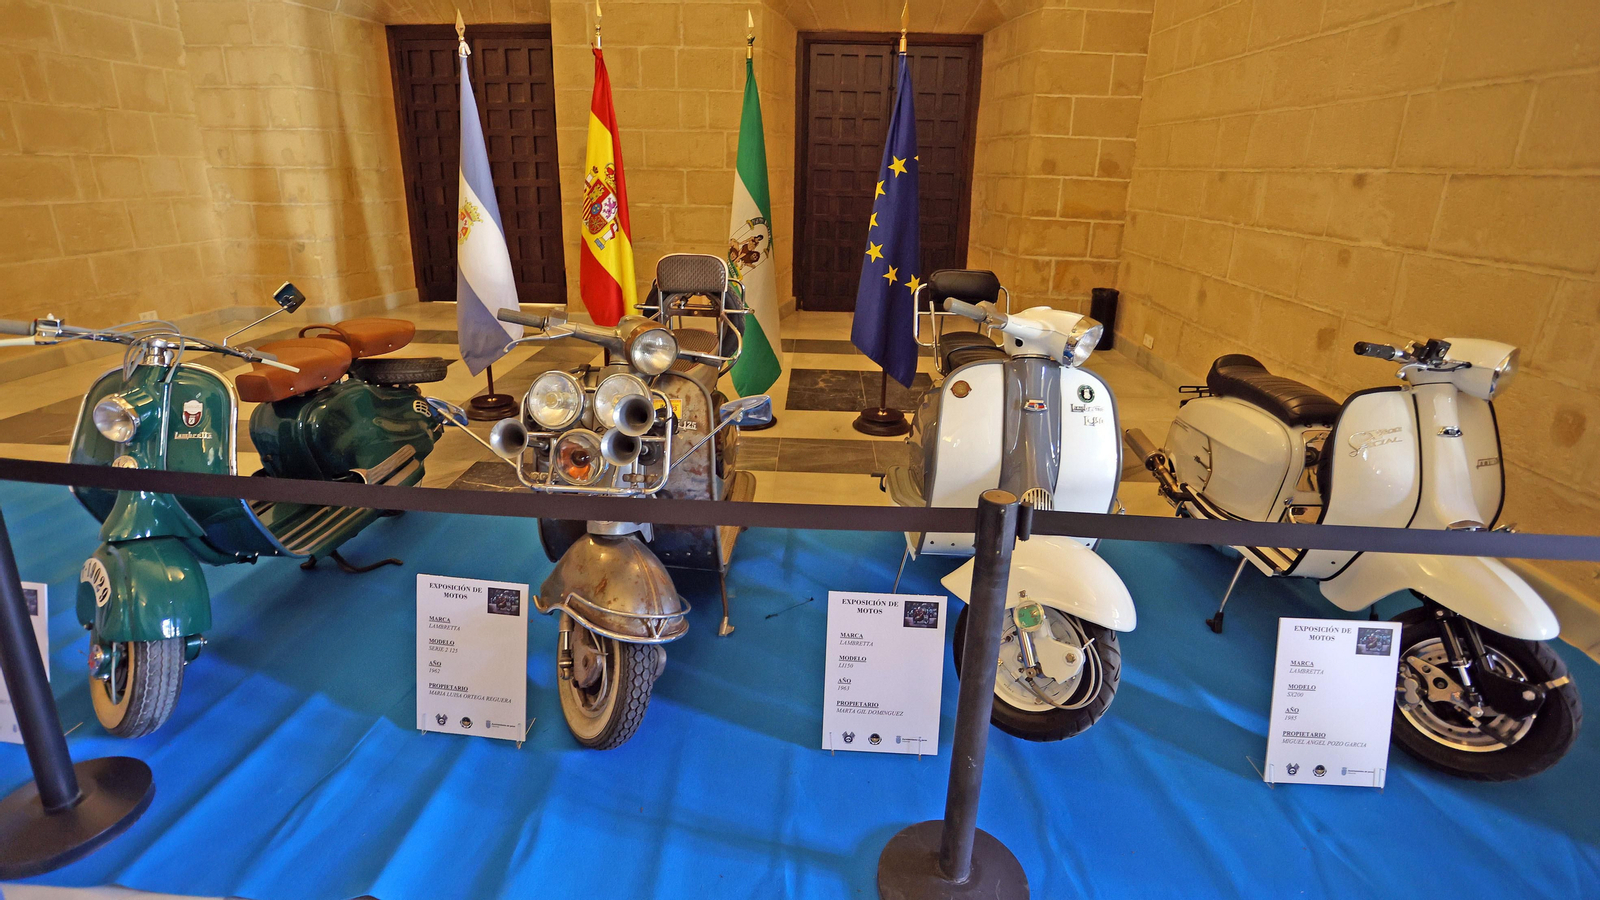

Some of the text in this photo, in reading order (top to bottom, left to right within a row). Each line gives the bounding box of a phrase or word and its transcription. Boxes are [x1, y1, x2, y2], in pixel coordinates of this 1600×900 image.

[429, 582, 471, 592] EXPOSICIÓN
[444, 592, 468, 600] MOTOS
[842, 598, 886, 606] EXPOSICIÓN
[429, 615, 450, 623] MARCA
[429, 623, 460, 631] LAMBRETTA
[1294, 625, 1339, 633] EXPOSICIÓN
[429, 638, 454, 646] MODELO
[429, 683, 468, 692] PROPIETARIO
[464, 693, 485, 701] ORTEGA
[486, 695, 512, 703] REGUERA
[837, 700, 879, 708] PROPIETARIO
[868, 709, 904, 717] DOMINGUEZ
